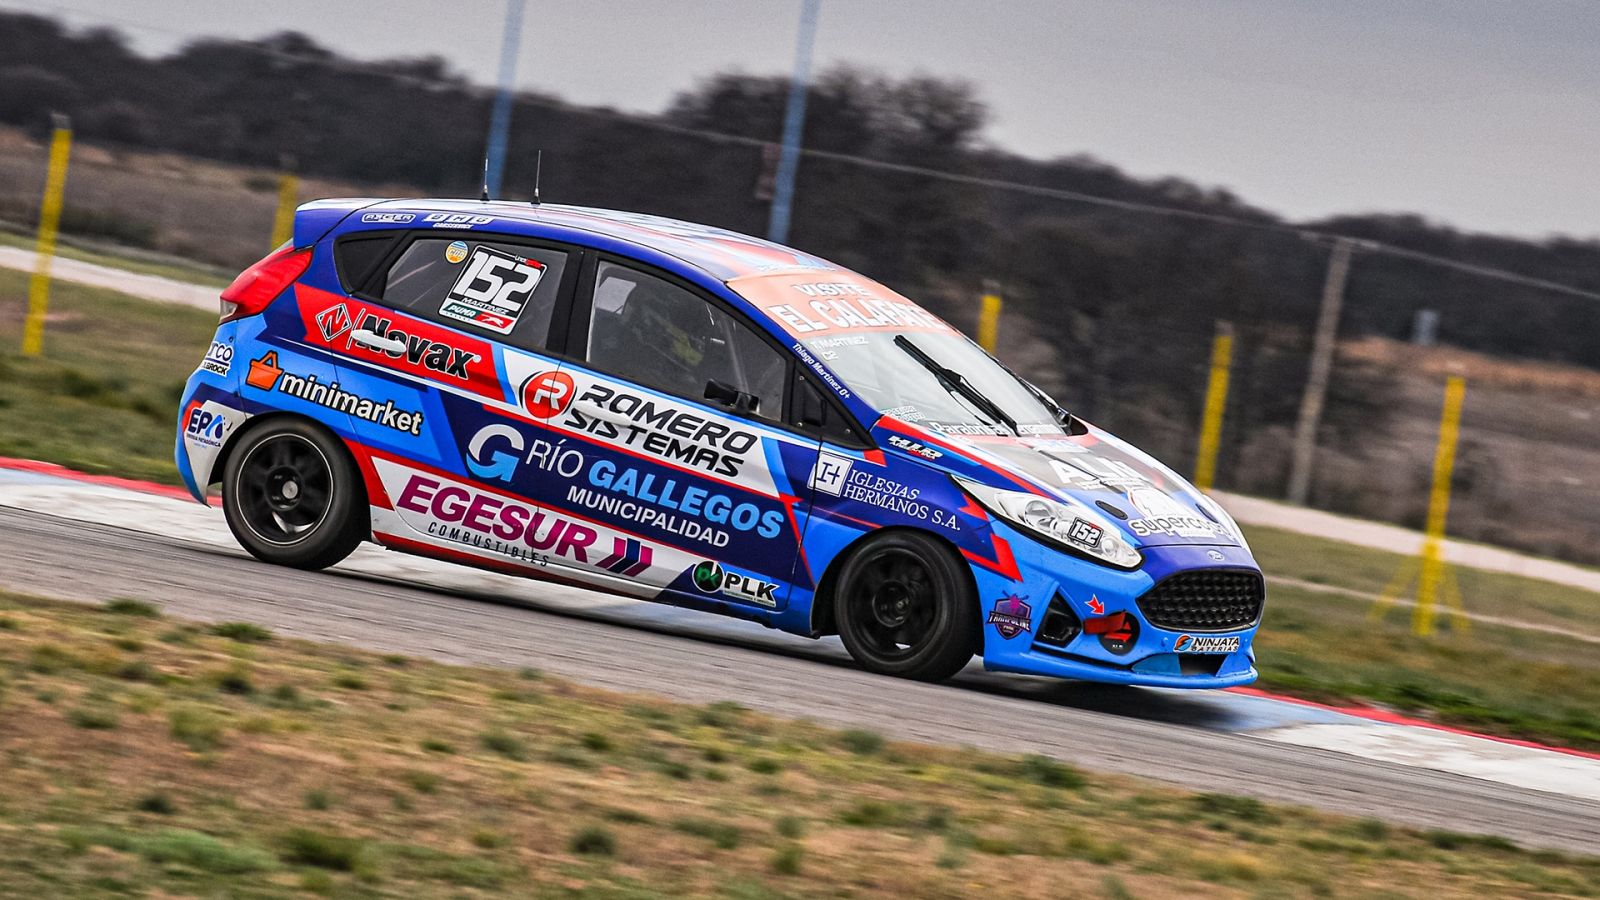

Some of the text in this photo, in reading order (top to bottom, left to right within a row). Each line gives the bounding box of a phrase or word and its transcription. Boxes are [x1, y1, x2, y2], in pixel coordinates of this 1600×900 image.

[453, 251, 541, 312] 152
[792, 282, 871, 297] VISITE
[448, 304, 477, 318] PUMA
[461, 297, 510, 315] MARTINEZ
[768, 298, 948, 333] EL CALAFATE
[792, 343, 815, 365] Thiago
[279, 371, 424, 436] minimarket
[578, 384, 758, 455] ROMERO
[564, 407, 745, 478] SISTEMAS
[526, 438, 785, 539] RÍO GALLEGOS
[848, 469, 920, 500] IGLESIAS
[396, 473, 598, 564] EGESUR
[566, 484, 730, 548] MUNICIPALIDAD
[843, 484, 961, 531] HERMANOS S.A.
[427, 521, 550, 568] COMBUSTIBLES
[1070, 520, 1101, 544] 152
[724, 572, 777, 602] PLK
[1194, 636, 1240, 646] NINJATA
